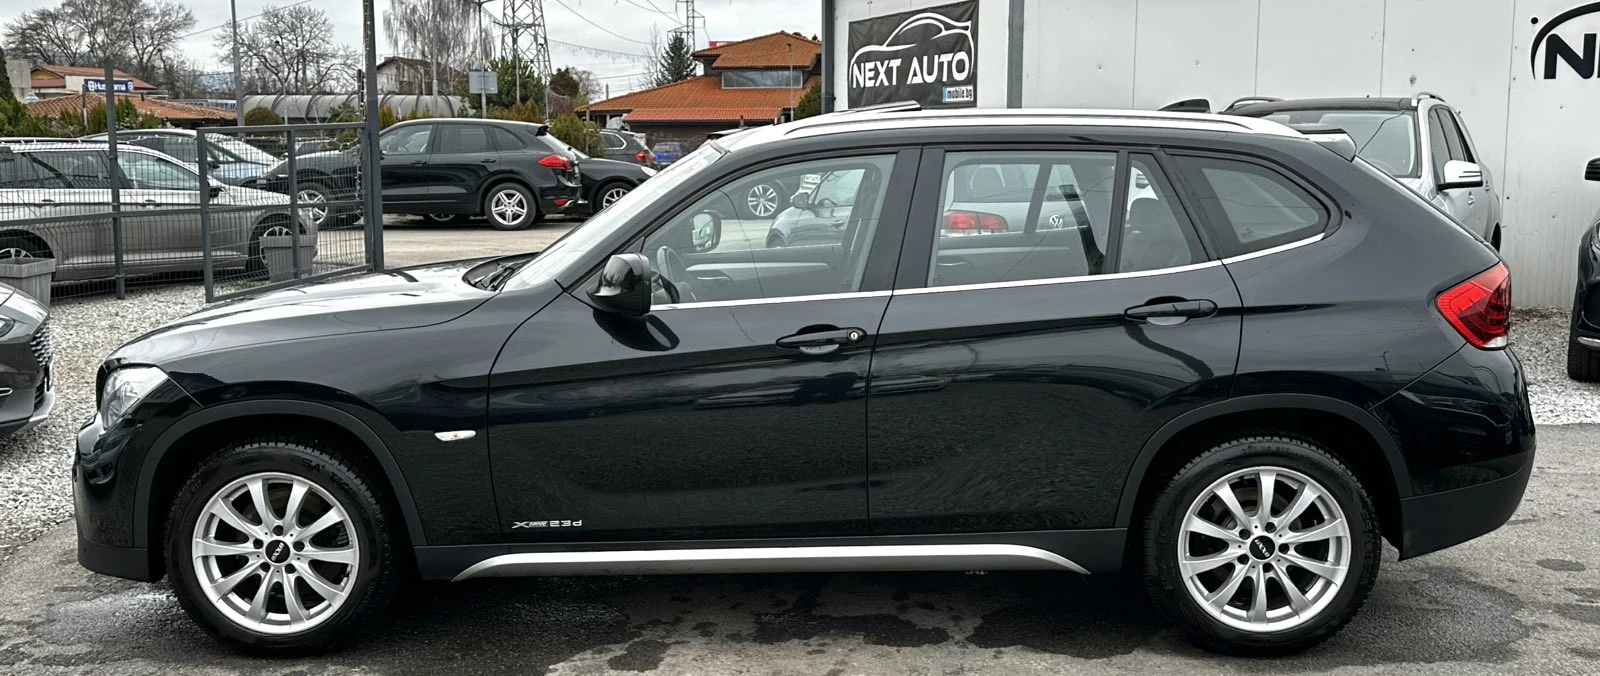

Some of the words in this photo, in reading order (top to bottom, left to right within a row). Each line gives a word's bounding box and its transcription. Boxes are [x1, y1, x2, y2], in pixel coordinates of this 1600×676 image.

[852, 58, 902, 89] NEXT
[906, 51, 970, 85] AUTO
[1543, 33, 1600, 80] N
[549, 519, 583, 527] 23d
